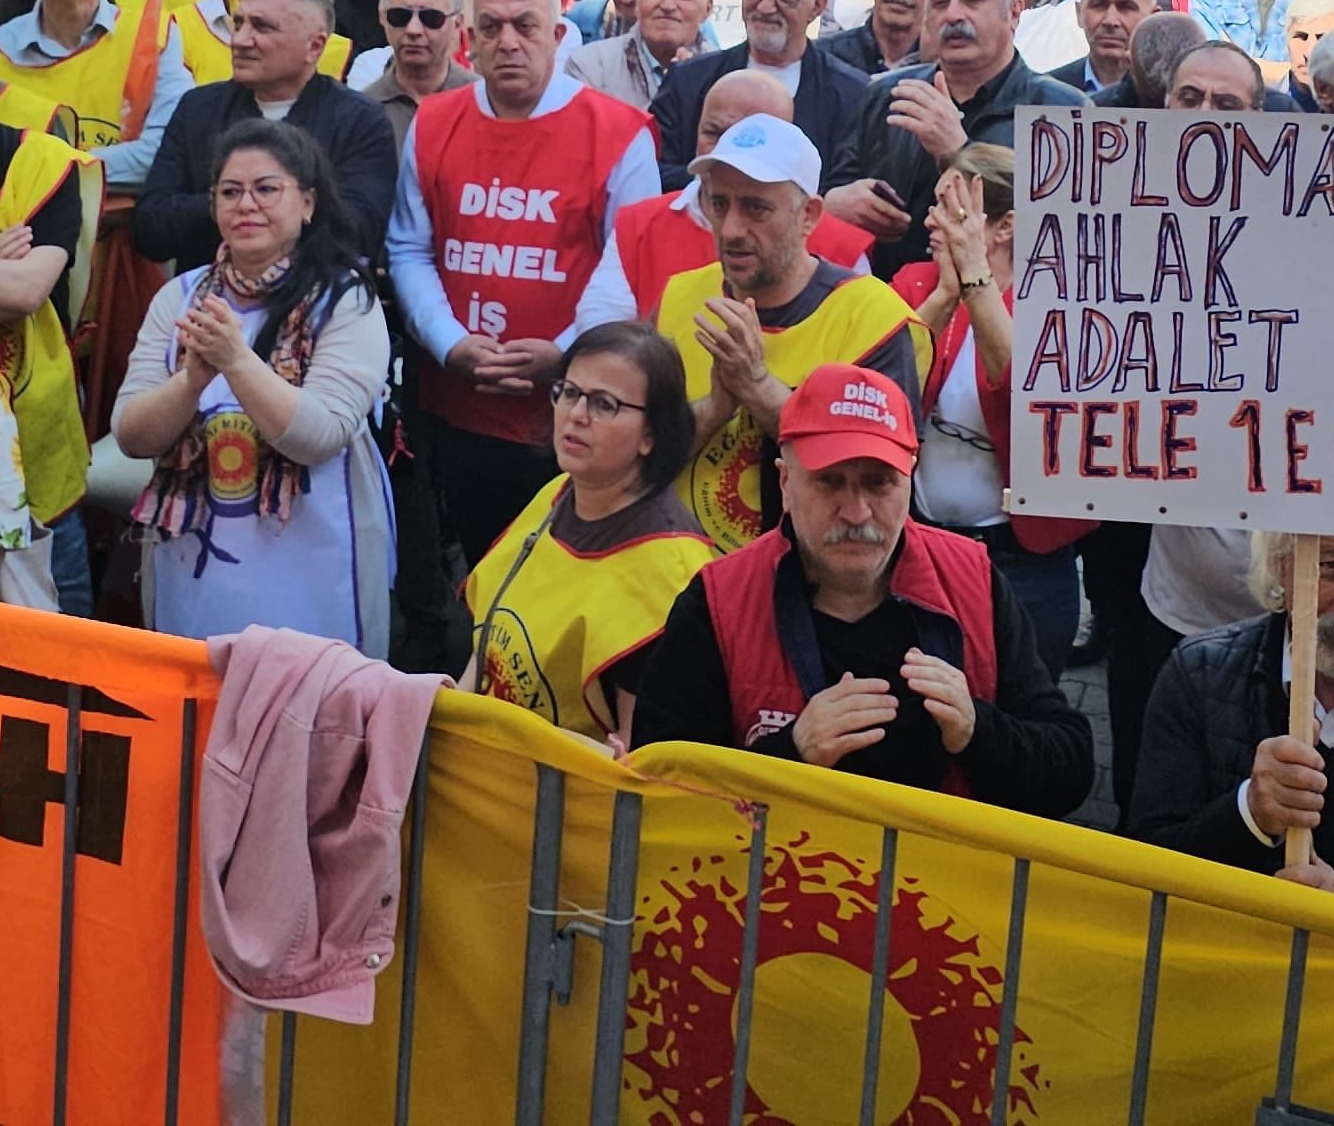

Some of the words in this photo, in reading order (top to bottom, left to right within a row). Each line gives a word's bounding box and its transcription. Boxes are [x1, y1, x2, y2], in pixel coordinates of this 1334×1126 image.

[459, 177, 561, 225] DİSK
[443, 238, 567, 284] GENEL
[1017, 212, 1249, 308] AHLAK
[467, 290, 507, 340] İŞ
[1023, 307, 1300, 393] ADALET
[829, 400, 898, 433] GENEL-İŞ
[843, 380, 889, 409] DİSK
[1028, 398, 1199, 481] TELE
[507, 651, 546, 711] SEN
